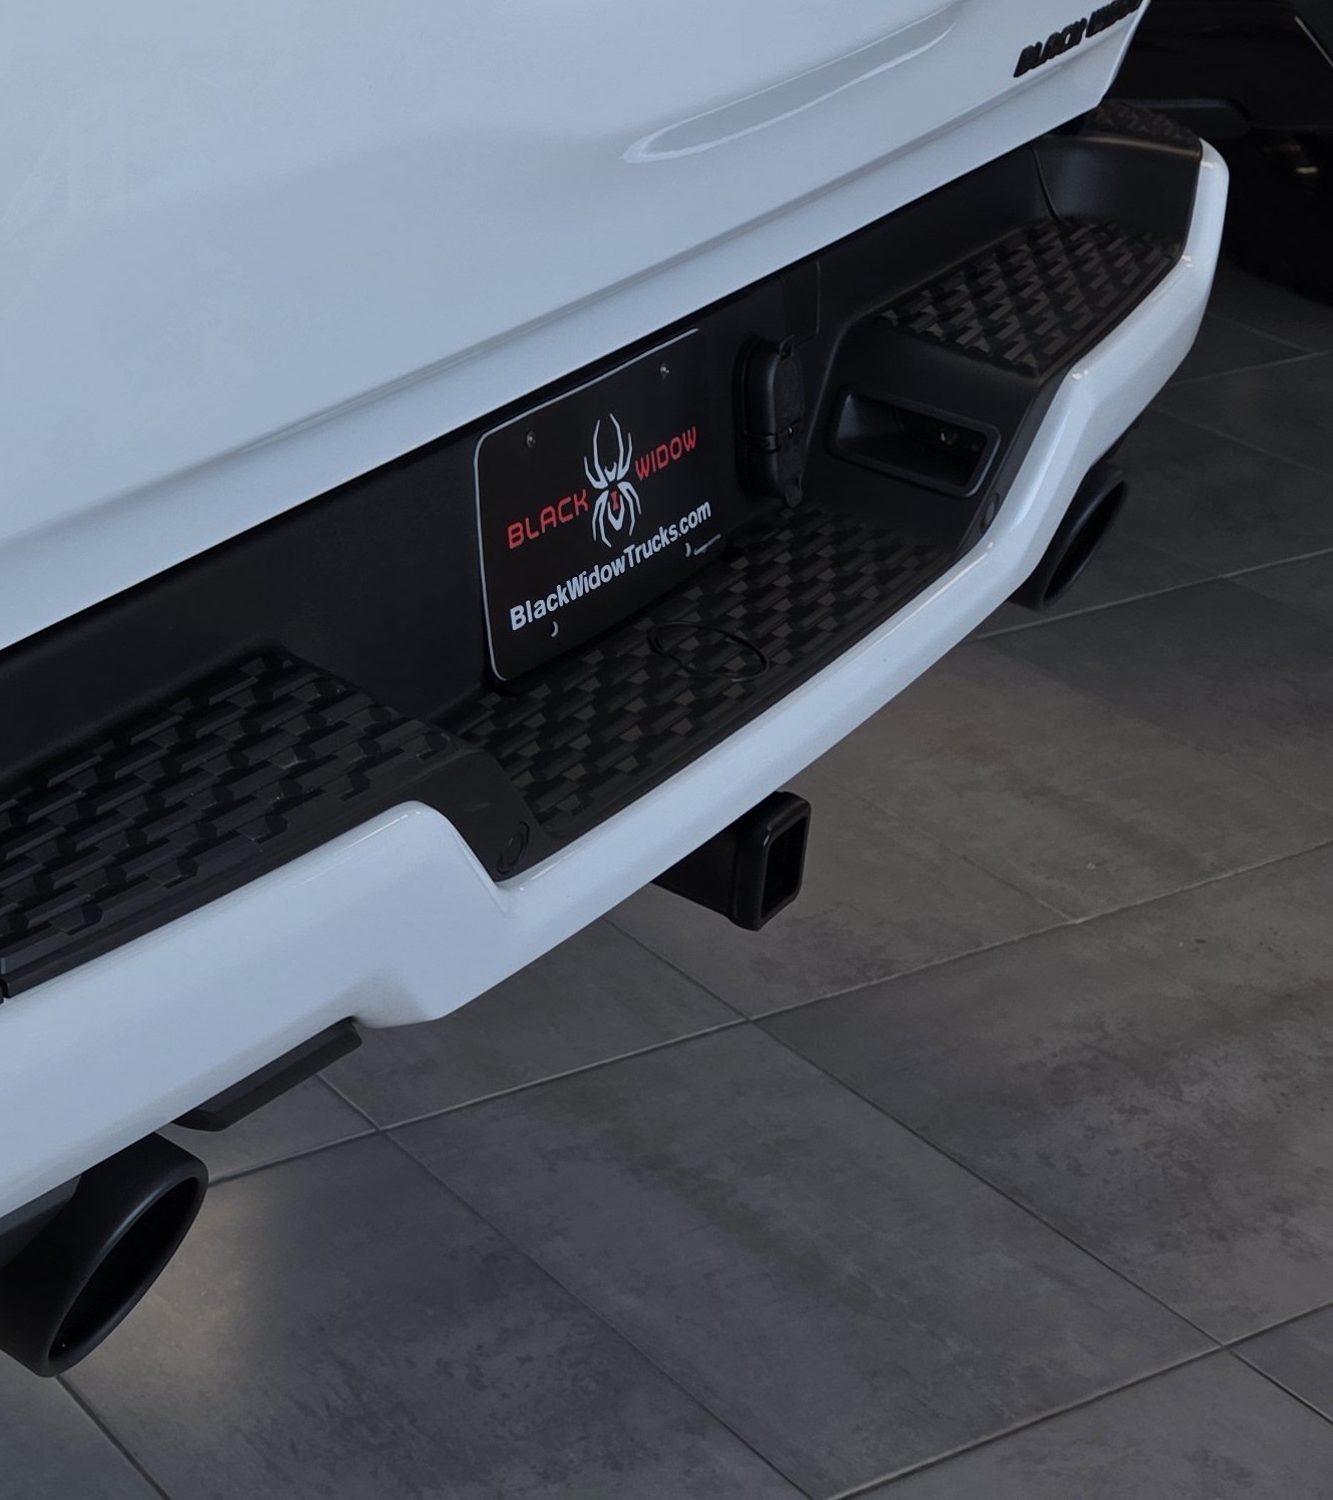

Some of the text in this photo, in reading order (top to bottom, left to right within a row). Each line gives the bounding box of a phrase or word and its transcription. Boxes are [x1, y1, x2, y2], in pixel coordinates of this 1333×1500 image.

[507, 426, 697, 550] BLACK WIDOW
[509, 501, 712, 631] BlackWidowTrucks.com
